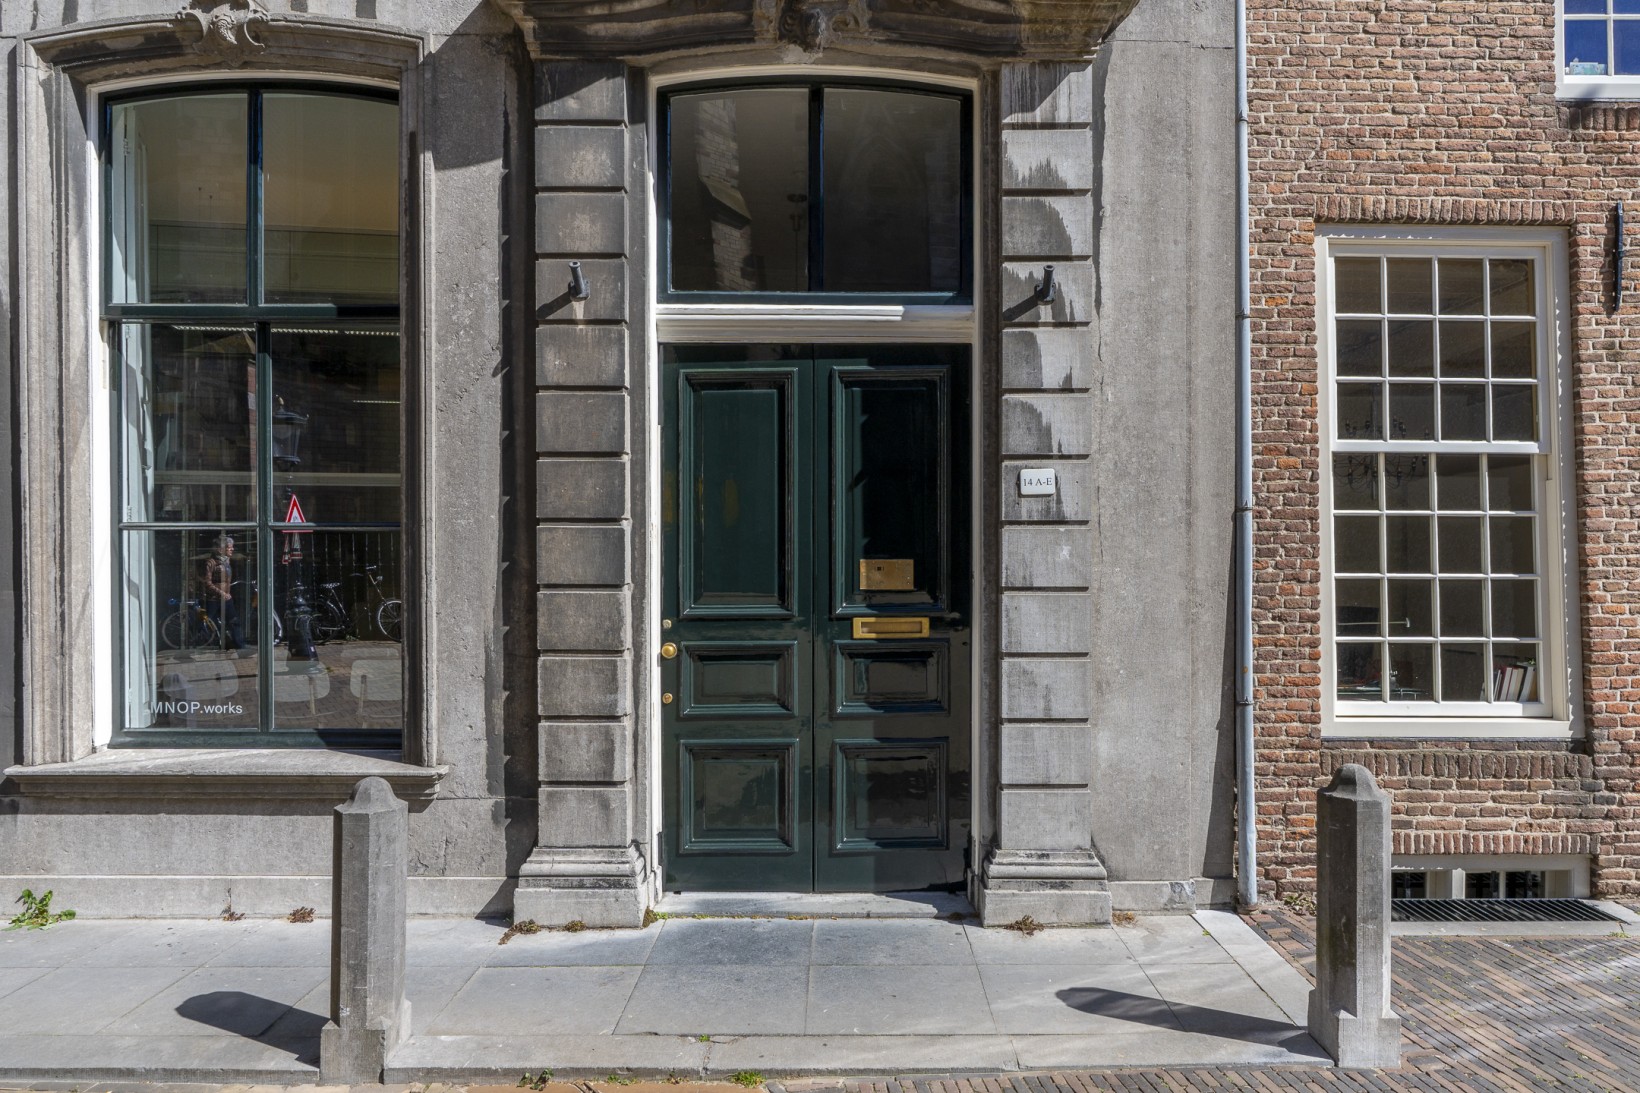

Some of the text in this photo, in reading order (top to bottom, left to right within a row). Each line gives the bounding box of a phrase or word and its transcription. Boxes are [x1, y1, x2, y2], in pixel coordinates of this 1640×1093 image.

[1023, 478, 1053, 486] 14 A-E
[150, 701, 243, 714] MNOP.works
